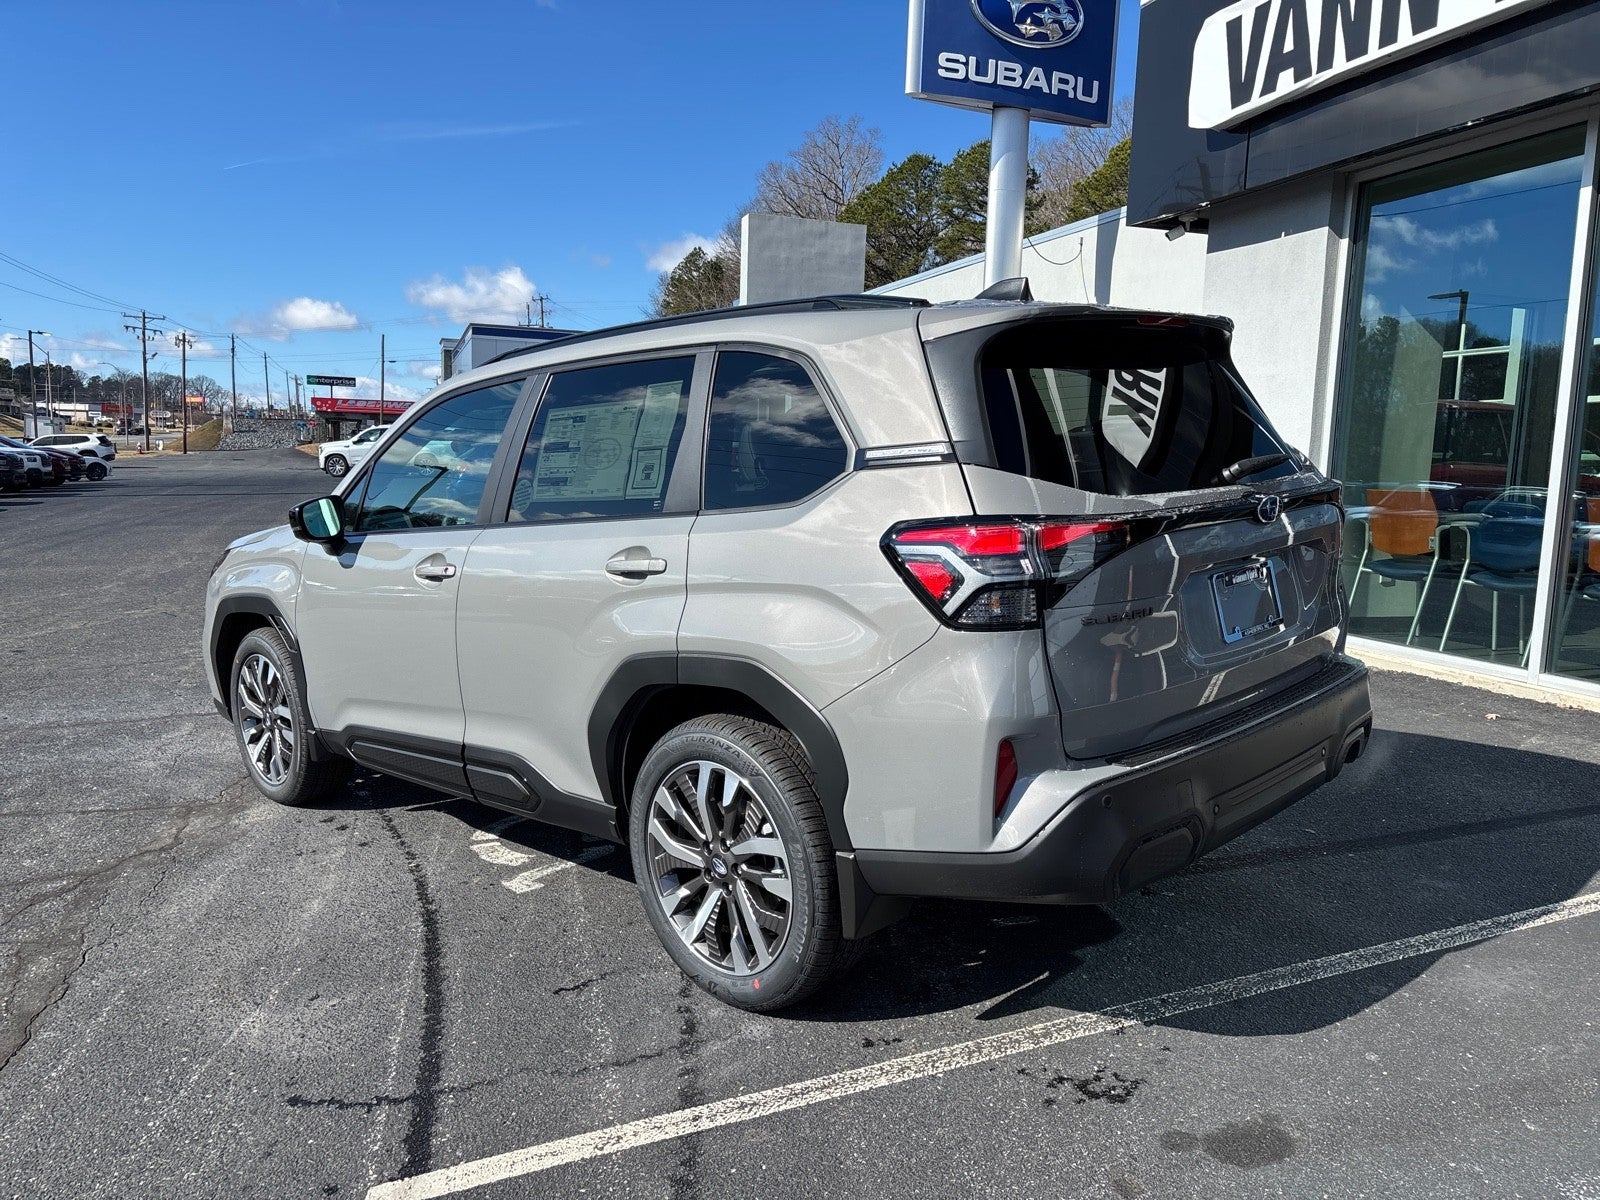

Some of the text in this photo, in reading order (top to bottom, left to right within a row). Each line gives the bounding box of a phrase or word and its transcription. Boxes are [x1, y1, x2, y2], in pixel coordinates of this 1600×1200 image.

[938, 52, 1099, 104] SUBARU
[309, 377, 355, 386] enterprise
[1081, 606, 1153, 626] SUBARU
[684, 735, 741, 759] TURANZA
